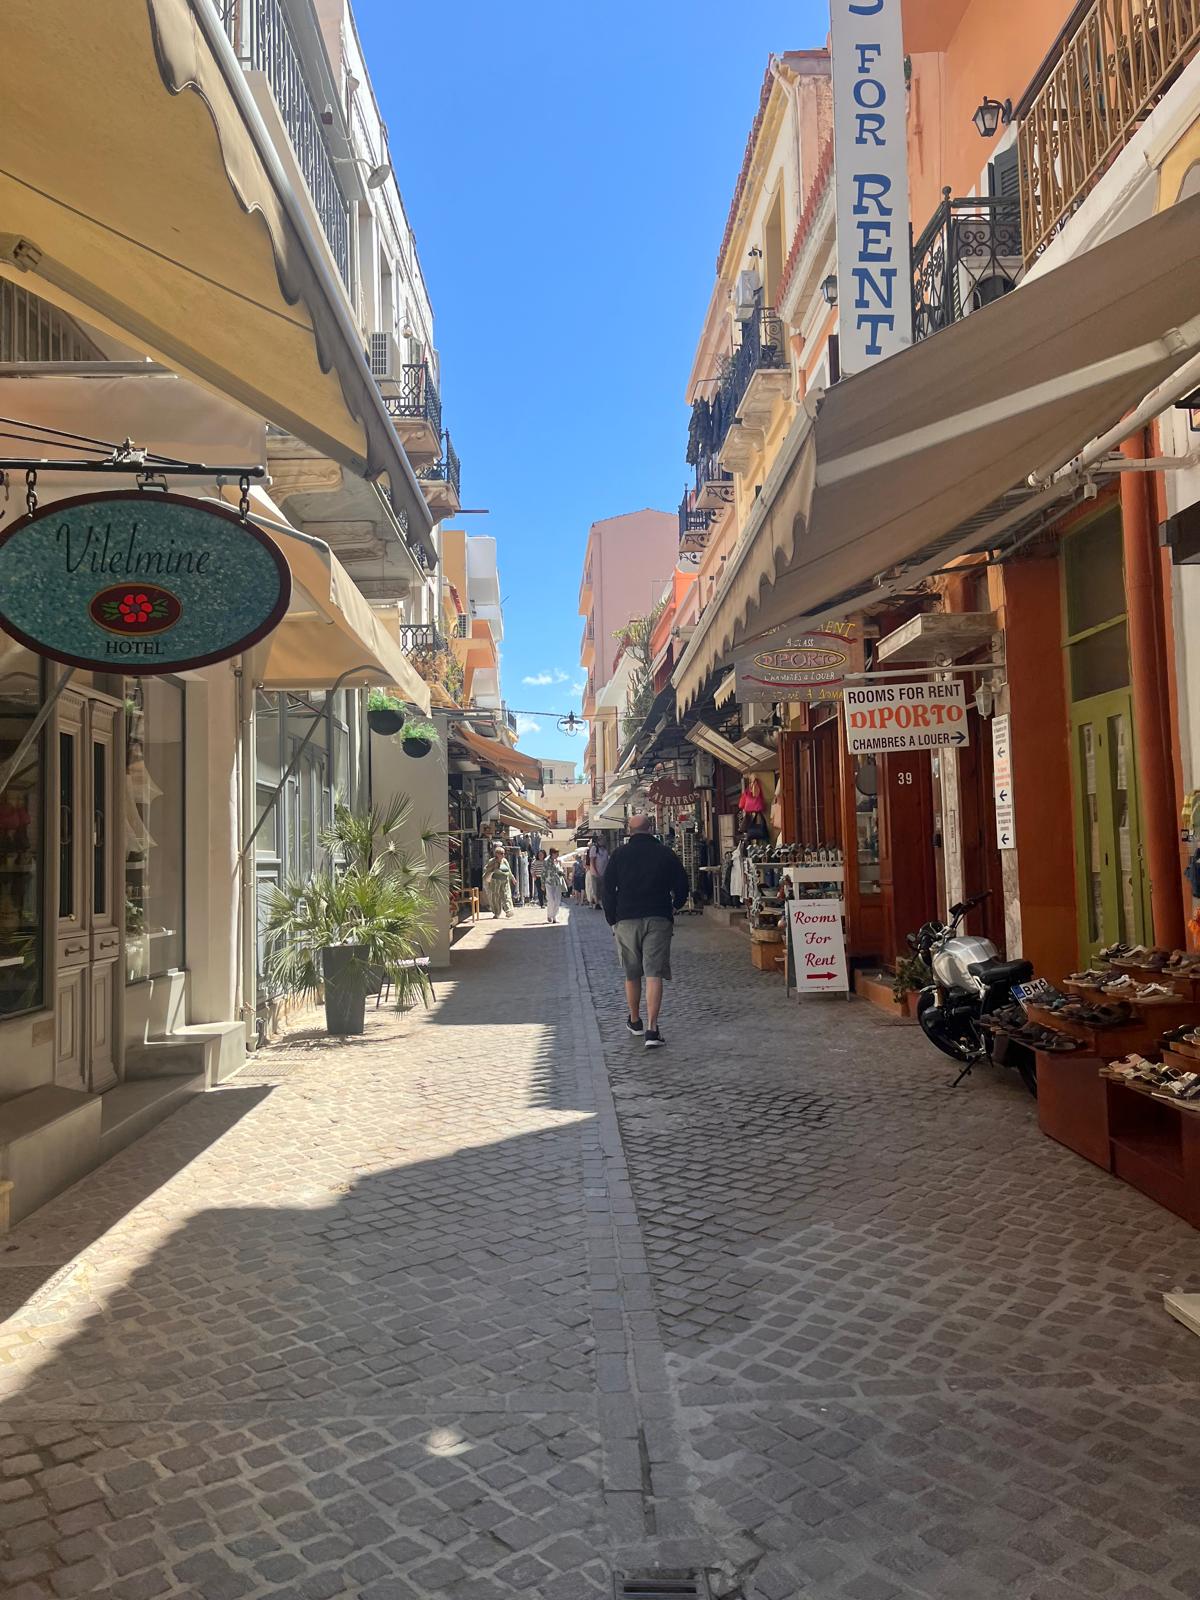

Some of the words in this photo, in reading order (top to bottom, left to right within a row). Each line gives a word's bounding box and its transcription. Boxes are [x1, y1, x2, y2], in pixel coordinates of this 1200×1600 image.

[853, 43, 887, 146] FOR
[851, 173, 898, 356] RENT
[56, 523, 211, 574] Vilelmine
[105, 641, 165, 655] HOTEL
[848, 688, 895, 704] ROOMS
[899, 686, 925, 701] FOR
[928, 684, 961, 698] RENT
[850, 703, 964, 729] DIPORTO
[853, 735, 906, 750] CHAMBRES
[908, 735, 916, 746] A
[918, 732, 950, 746] LOUER
[897, 772, 913, 785] 39
[652, 790, 700, 805] ALBATROS
[794, 911, 838, 925] Rooms
[804, 932, 832, 945] For
[804, 952, 837, 968] Rent
